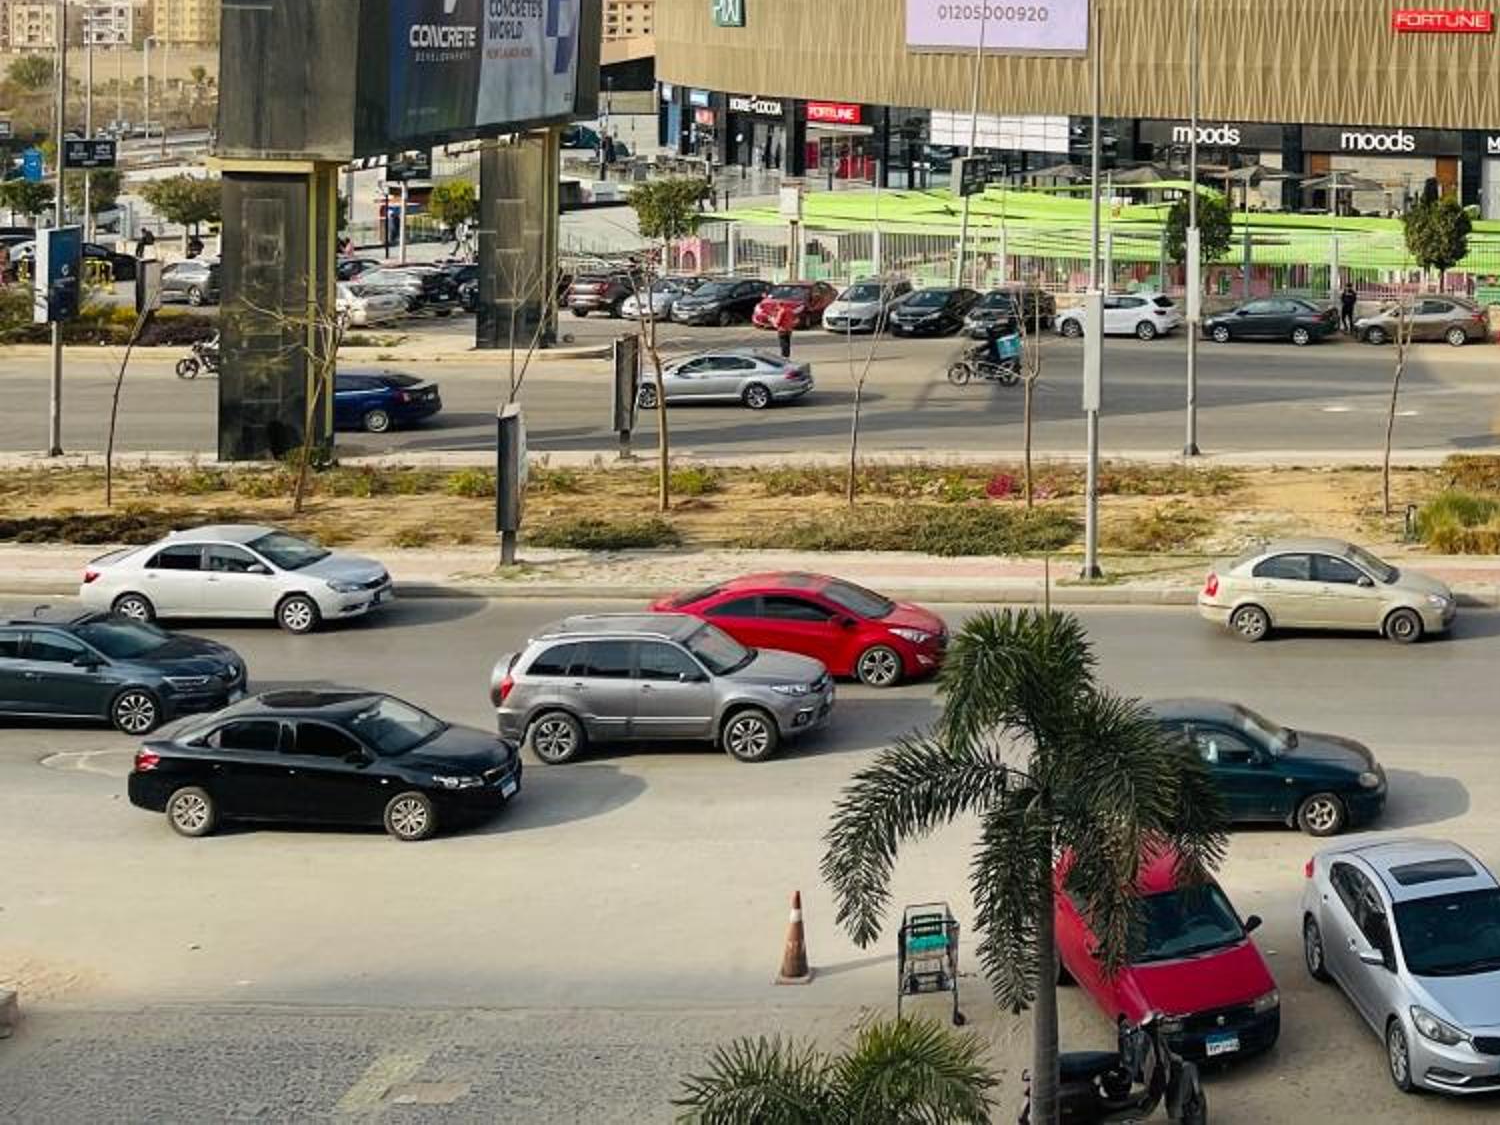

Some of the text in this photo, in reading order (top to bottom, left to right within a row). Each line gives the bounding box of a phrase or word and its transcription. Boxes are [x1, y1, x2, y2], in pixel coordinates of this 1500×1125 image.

[937, 5, 1049, 22] 01205000920
[1396, 13, 1488, 27] FORTUNE
[409, 24, 477, 48] CONCRETE
[489, 20, 523, 40] WORLD
[1172, 124, 1241, 145] moods
[1341, 130, 1415, 151] moods
